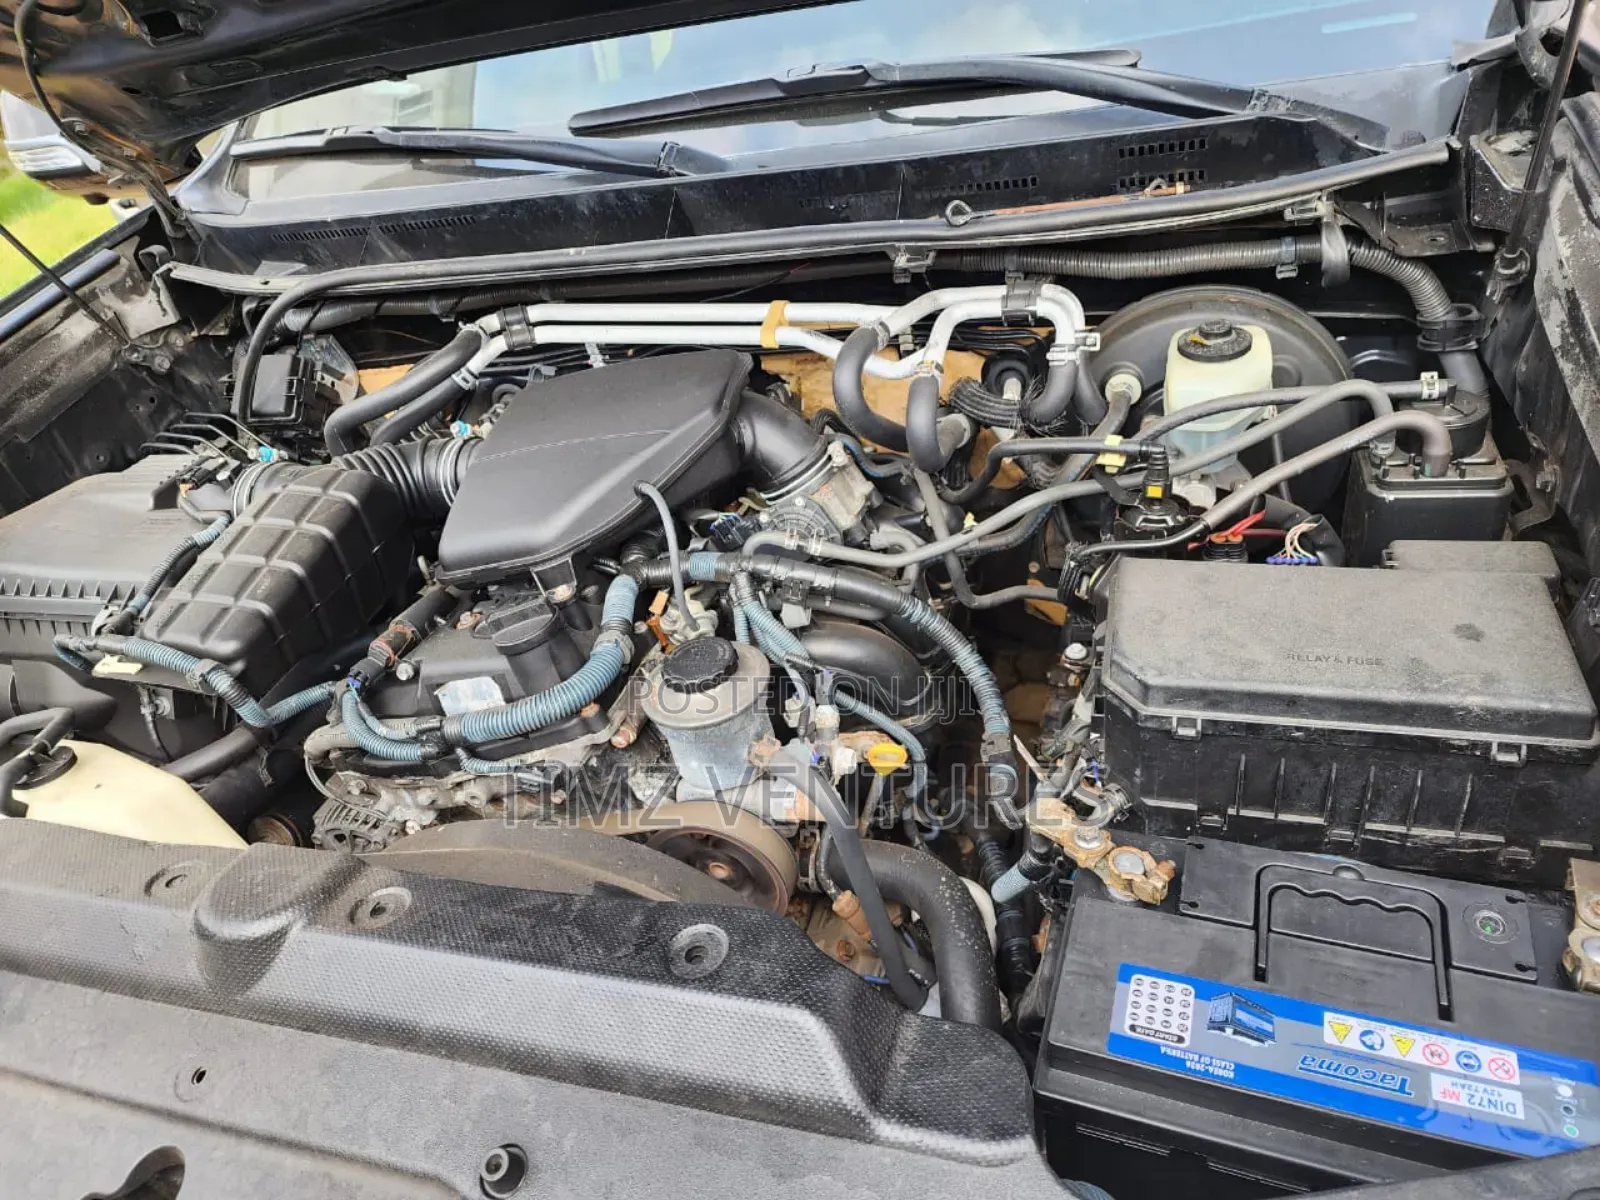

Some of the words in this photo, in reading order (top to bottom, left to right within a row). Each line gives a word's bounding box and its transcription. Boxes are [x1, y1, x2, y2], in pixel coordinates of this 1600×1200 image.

[1286, 653, 1331, 664] RELAY
[1333, 653, 1344, 665] &
[1347, 655, 1384, 667] FUSE
[1200, 1056, 1211, 1065] OF
[1212, 1058, 1235, 1071] CLASS
[1299, 1055, 1414, 1097] Tacoma
[1450, 1081, 1480, 1093] 72AH
[1482, 1087, 1502, 1098] 12V
[1440, 1089, 1461, 1101] MF
[1467, 1093, 1518, 1115] DIN72
